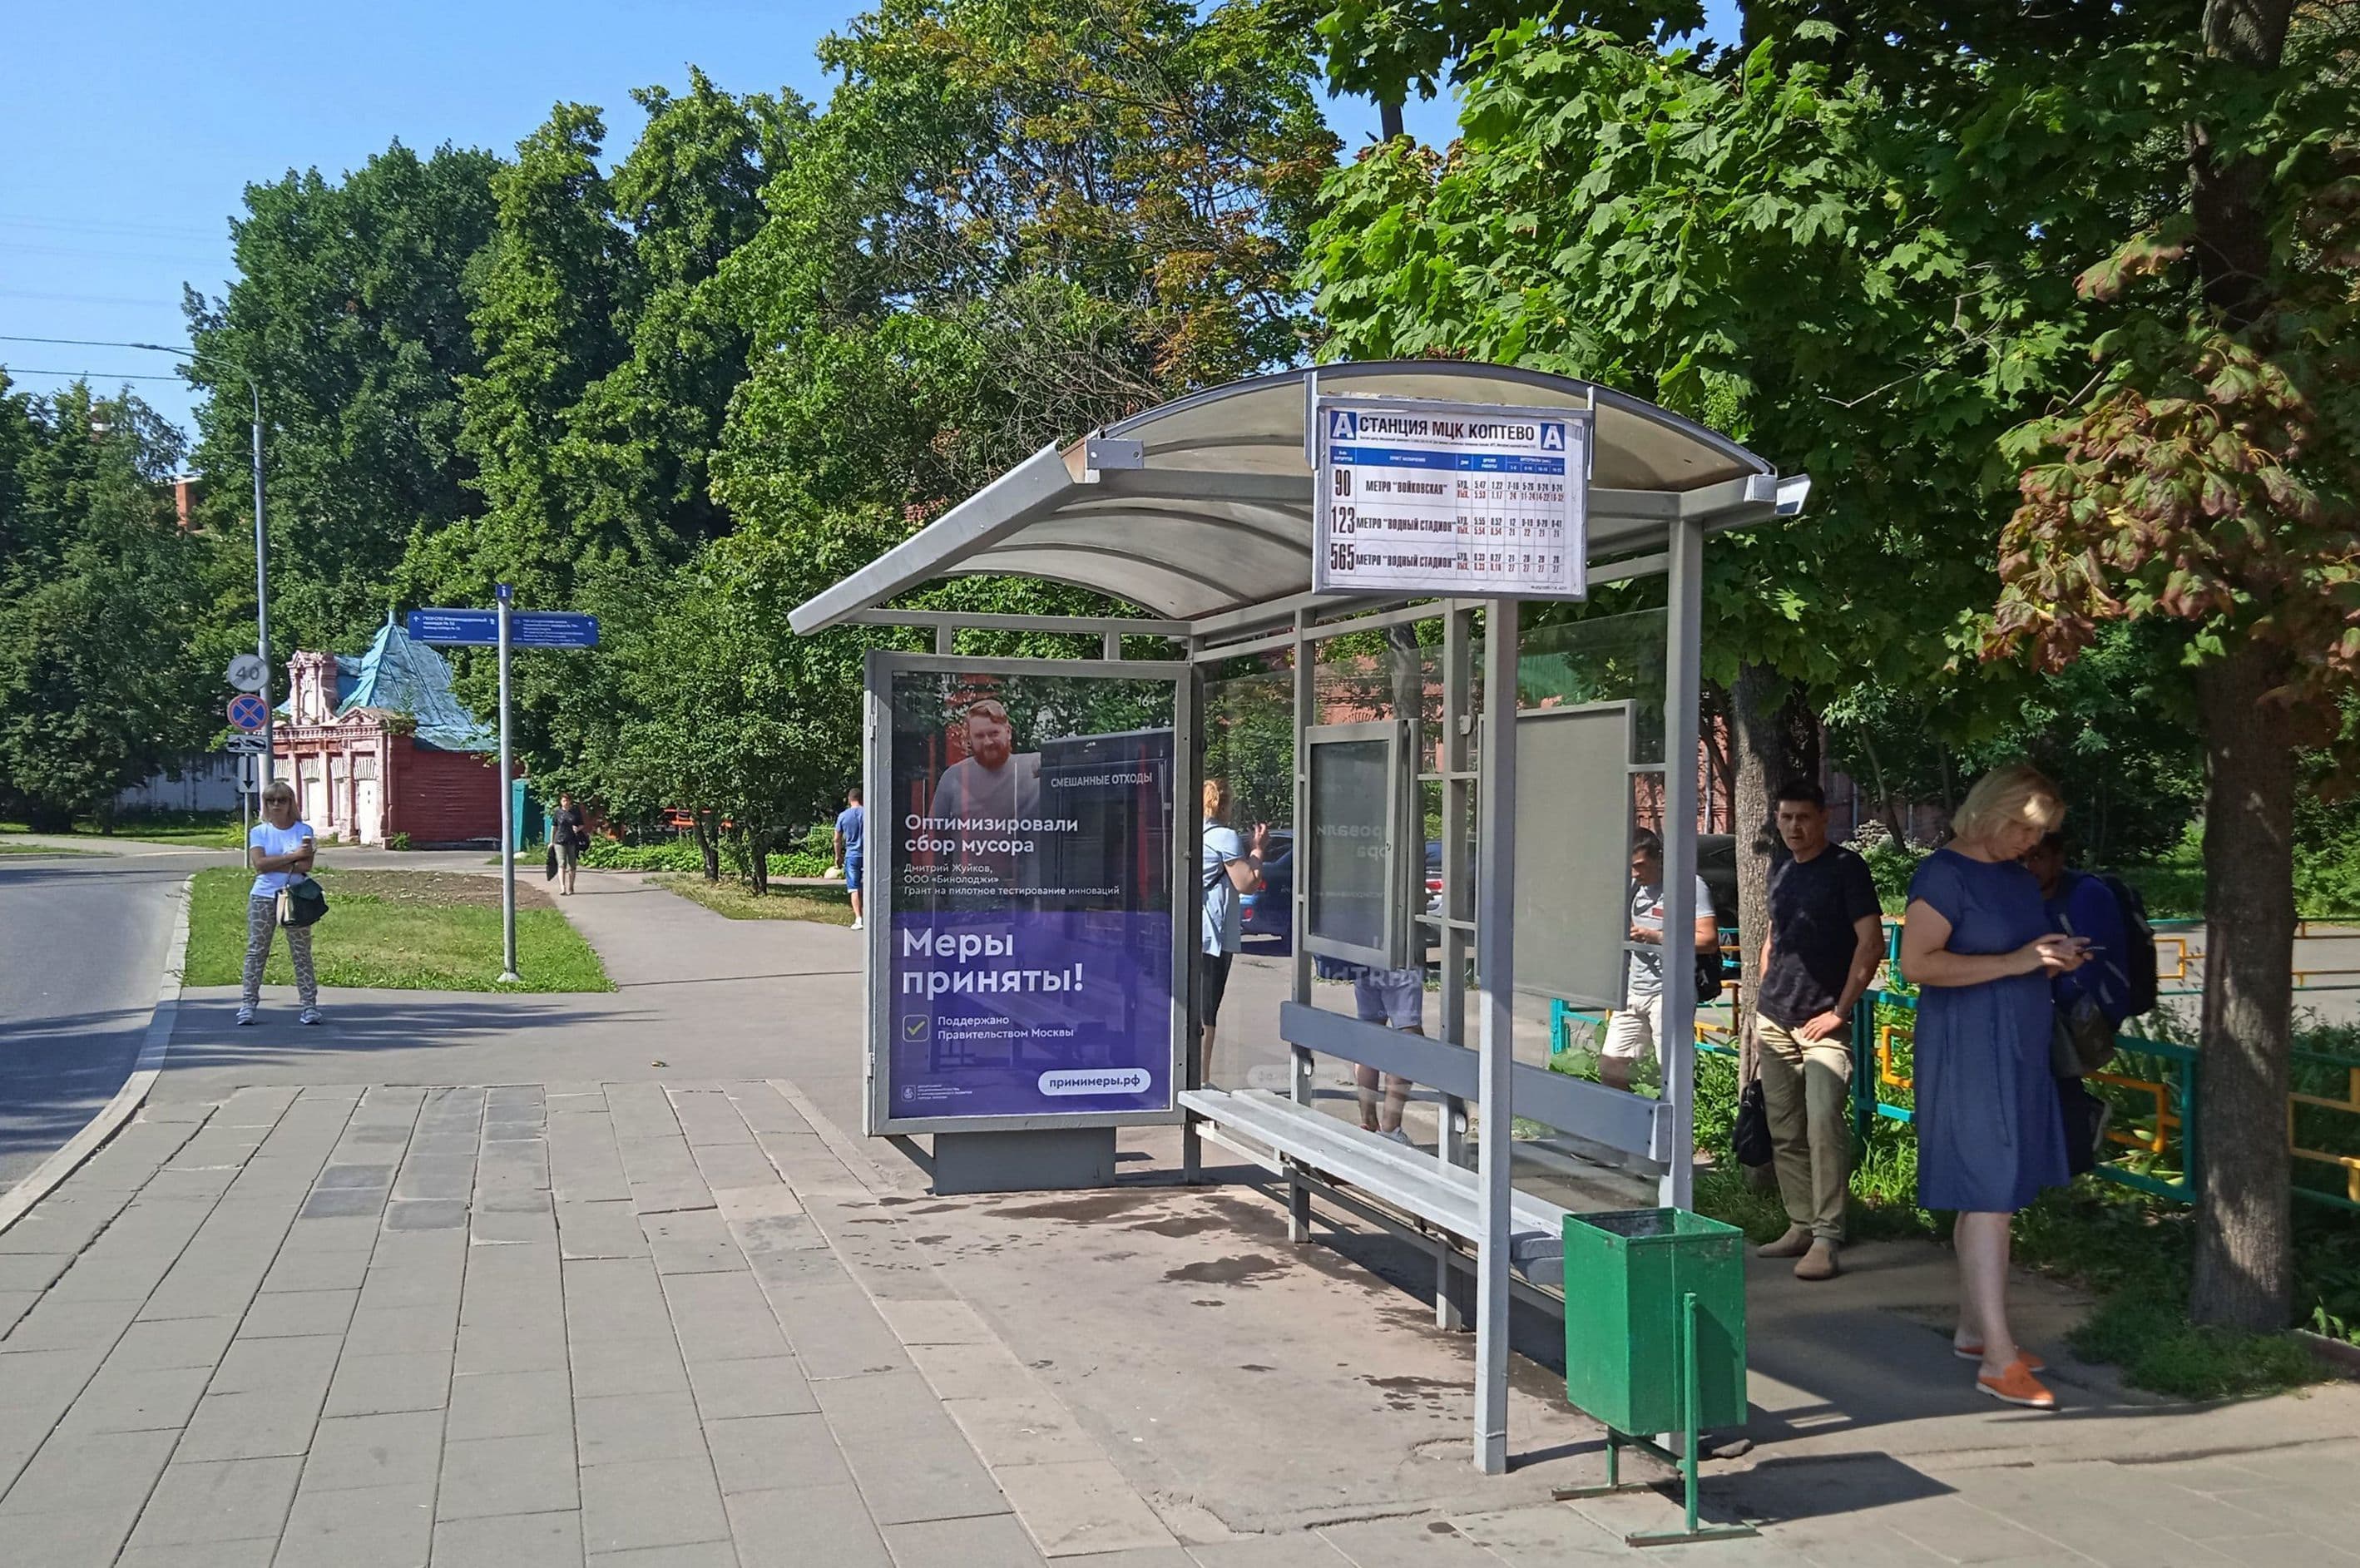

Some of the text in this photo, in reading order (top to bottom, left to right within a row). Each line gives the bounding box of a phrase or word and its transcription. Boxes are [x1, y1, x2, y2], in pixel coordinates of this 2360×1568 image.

[1360, 417, 1535, 441] СТАНЦИЯ МЦК КОПТЕВО
[1335, 469, 1351, 497] 90
[1366, 481, 1391, 492] МЕТРО
[1331, 506, 1355, 534] 123
[1356, 517, 1382, 529] МЕТРО
[1331, 543, 1355, 571] 565
[1356, 554, 1382, 566] МЕТРО
[235, 666, 260, 680] 40
[1051, 772, 1153, 788] СМЕШАННЫЕ ОТХОДЫ
[904, 814, 1079, 834] Оптимизировали
[904, 834, 1035, 856] сбор мусора
[904, 863, 993, 875] Дмитрий Жуйков,
[904, 875, 999, 884] ООО «Бинолоджи»
[904, 886, 932, 896] Грант
[998, 888, 1066, 897] тестирование
[1068, 886, 1120, 896] инноваций
[903, 927, 1014, 963] Меры
[903, 963, 1083, 1001] приняты!
[938, 1016, 1009, 1028] Поддержано
[938, 1027, 1074, 1041] Правительством Москвы
[1049, 1073, 1140, 1089] примимеры.рф
